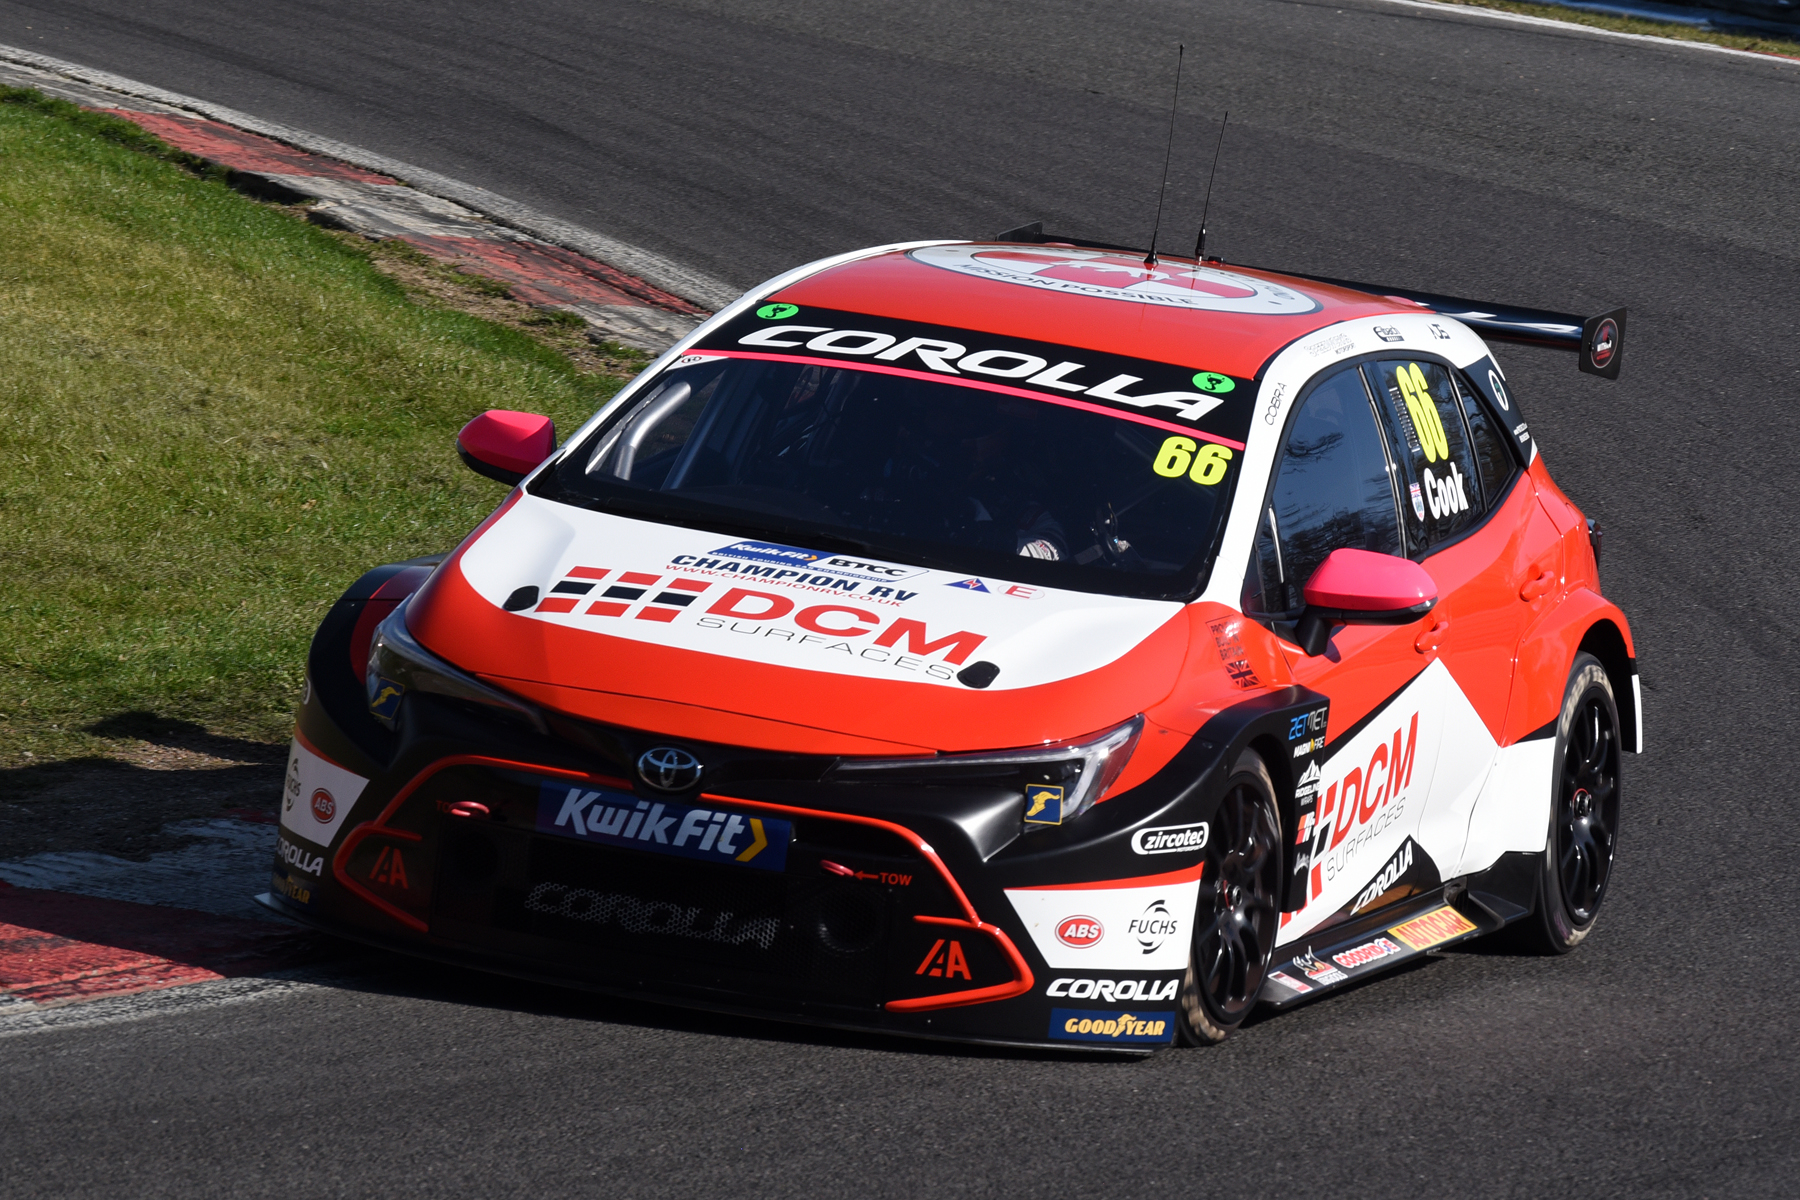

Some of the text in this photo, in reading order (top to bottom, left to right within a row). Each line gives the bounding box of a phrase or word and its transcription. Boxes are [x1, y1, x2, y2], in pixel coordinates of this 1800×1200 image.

[1060, 283, 1198, 306] POSSIBLE
[737, 325, 1224, 421] COROLLA
[1264, 382, 1287, 426] COBRA
[1396, 362, 1449, 463] 66
[1153, 435, 1234, 486] 66
[1423, 461, 1469, 520] Cook
[665, 564, 904, 608] WWW.CHAMPIONRV.CO.UK
[670, 553, 919, 602] CHAMPION RV
[827, 558, 909, 577] BTCC
[696, 616, 955, 681] SURFACES
[705, 587, 988, 666] DCM
[1329, 711, 1419, 852] DCM
[314, 796, 335, 815] ABS
[276, 835, 325, 877] OROLLA
[1144, 829, 1204, 850] zircotec
[1327, 796, 1406, 882] SURFACES
[879, 871, 912, 886] TOW
[1350, 840, 1414, 916] COROLLA
[524, 880, 781, 949] COROLLA
[1063, 923, 1100, 940] ABS
[1128, 918, 1178, 936] FUCHS
[1395, 908, 1473, 949] AUTOCAR
[1334, 938, 1400, 967] GOODRIDGE
[1046, 977, 1180, 1002] COROLLA
[1064, 1016, 1166, 1038] GOODYEAR
